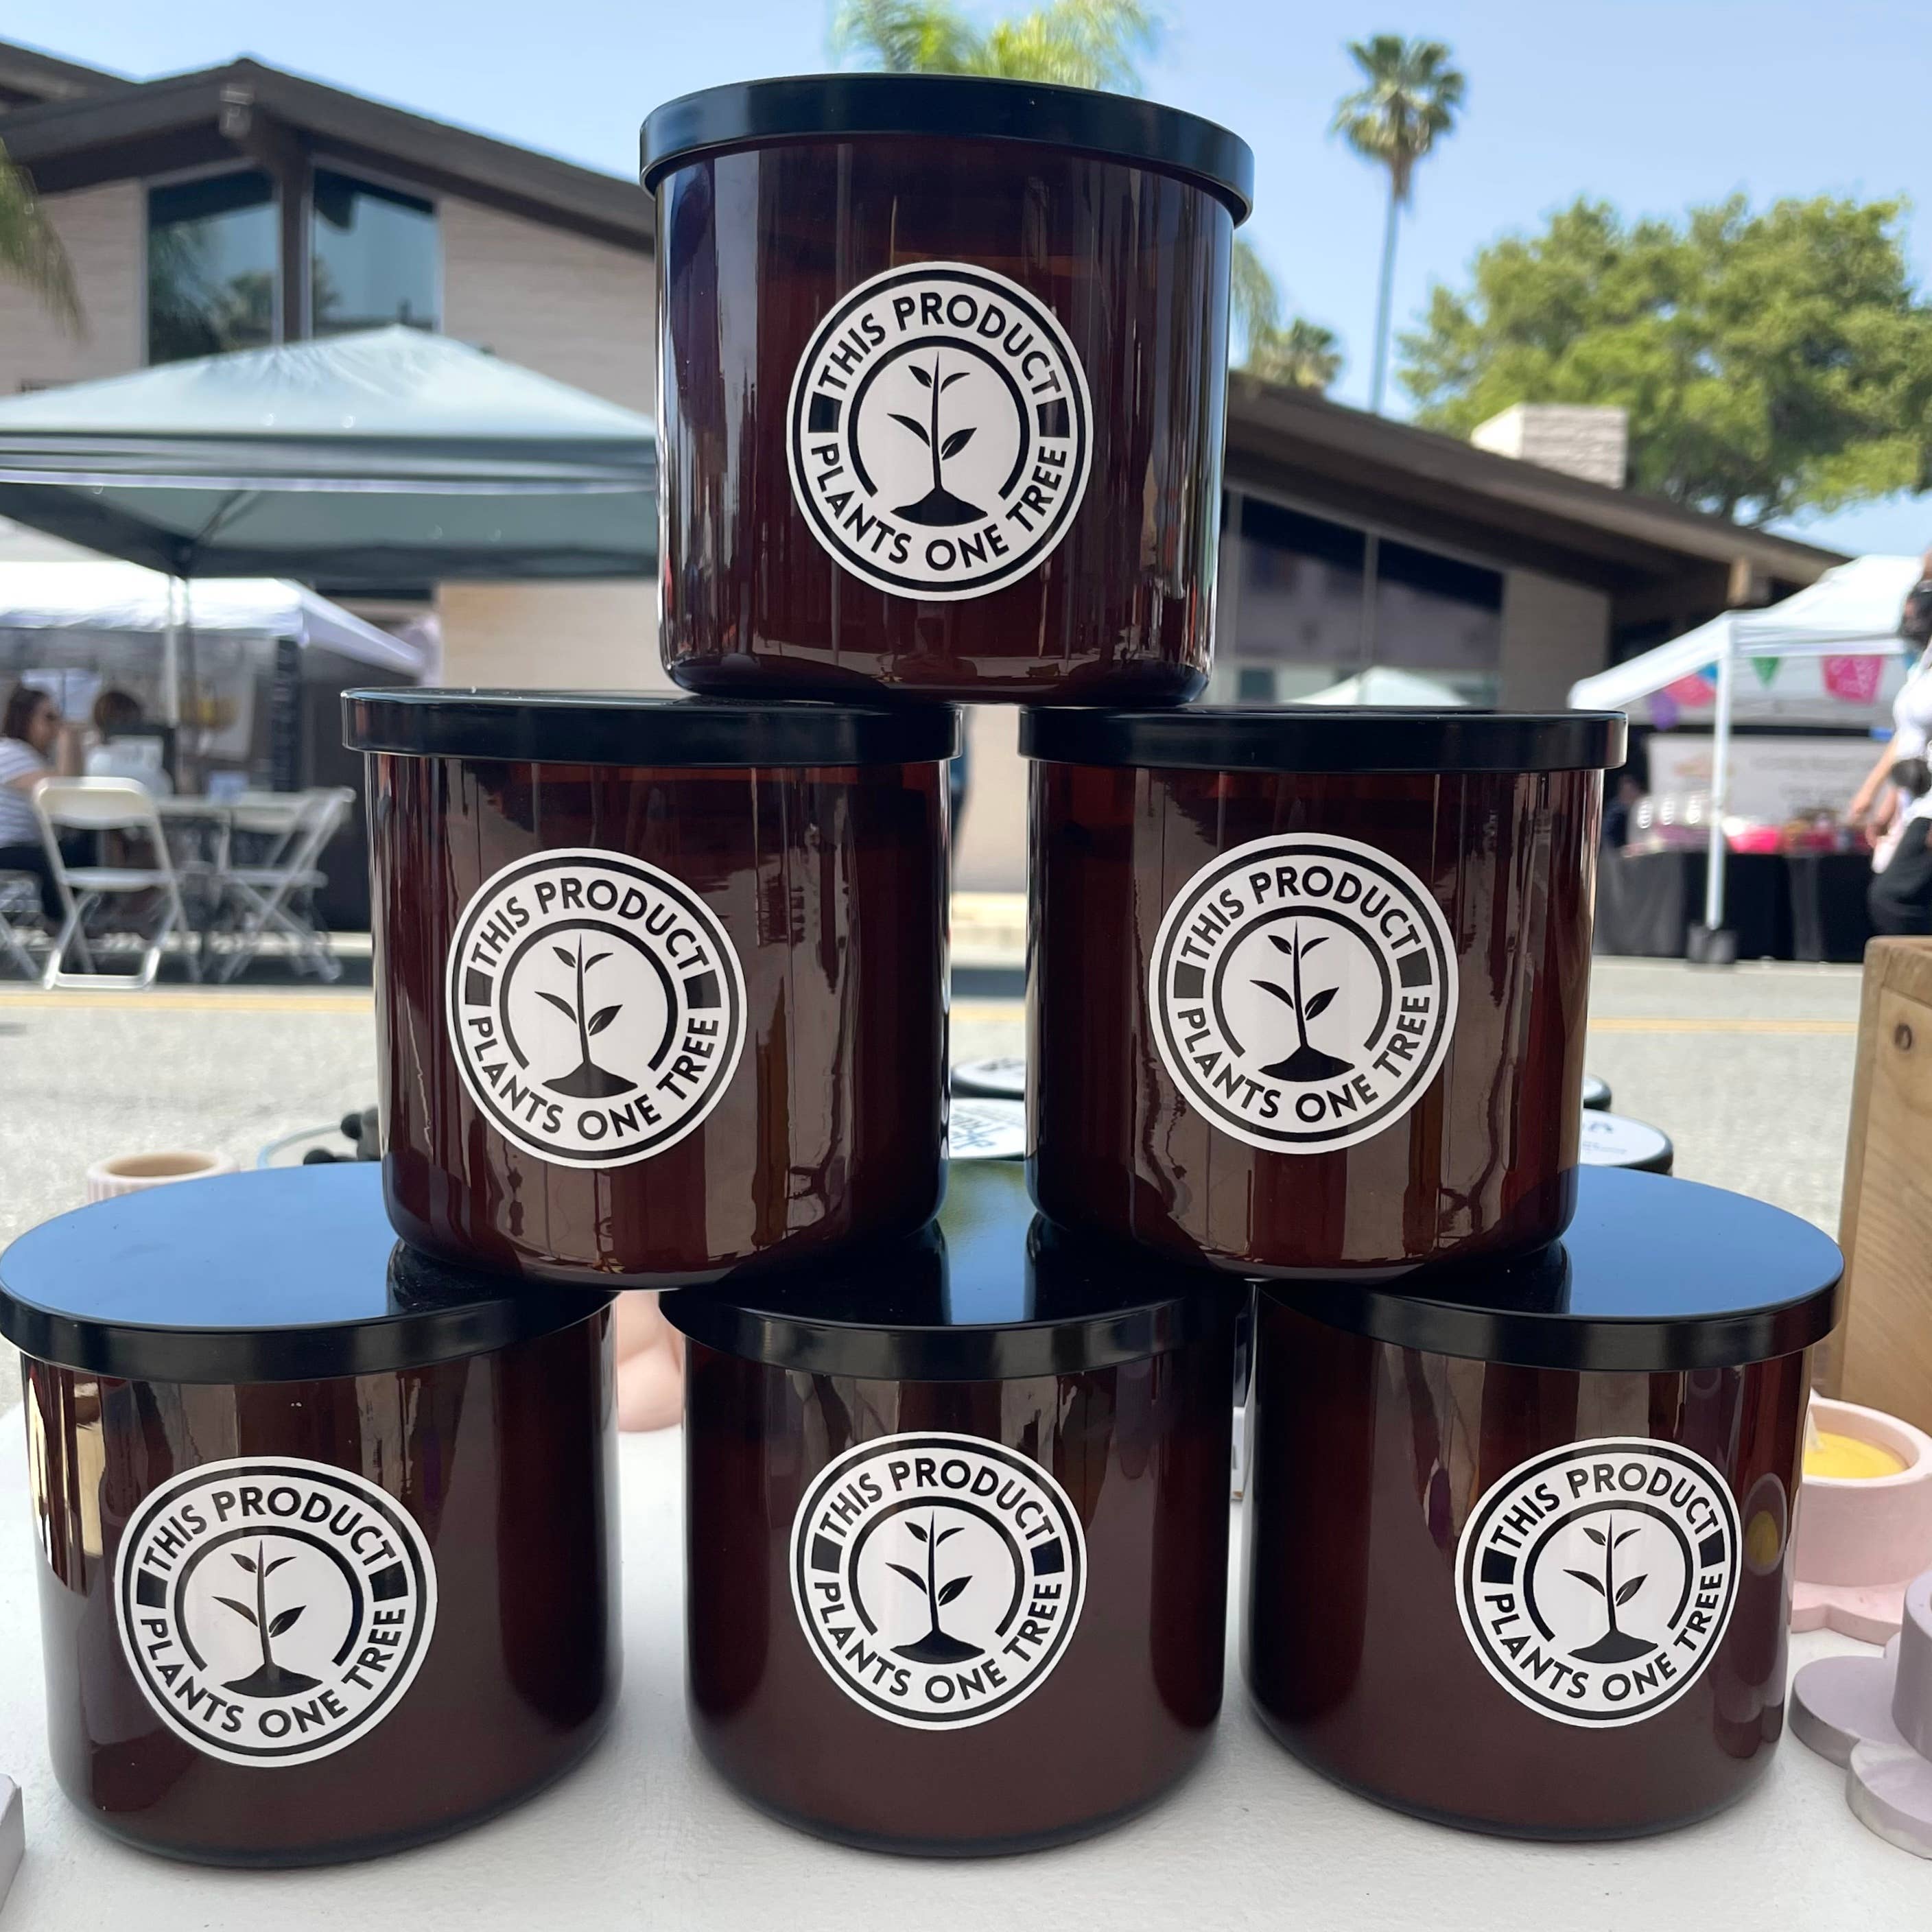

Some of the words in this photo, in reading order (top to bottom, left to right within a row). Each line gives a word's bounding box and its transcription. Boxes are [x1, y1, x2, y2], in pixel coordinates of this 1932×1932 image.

[817, 312, 886, 391] THIS
[893, 292, 1061, 395] PRODUCT
[811, 443, 912, 564] PLANTS
[925, 523, 1010, 571] ONE
[1005, 445, 1067, 532] TREE
[470, 896, 530, 967] THIS
[534, 877, 711, 970] PRODUCT
[1181, 888, 1245, 961] THIS
[1249, 865, 1422, 950] PRODUCT
[468, 1015, 564, 1134] PLANTS
[577, 1094, 663, 1141] ONE
[657, 1017, 719, 1100] TREE
[1177, 1007, 1282, 1118] PLANTS
[1295, 1074, 1378, 1123] ONE
[1372, 996, 1430, 1079] TREE
[143, 1504, 207, 1571] THIS
[211, 1486, 397, 1566] PRODUCT
[818, 1472, 883, 1538] THIS
[888, 1457, 1056, 1540] PRODUCT
[1489, 1483, 1561, 1548] THIS
[1566, 1462, 1718, 1535] PRODUCT
[140, 1618, 244, 1733] PLANTS
[258, 1689, 349, 1738] ONE
[341, 1608, 406, 1690] TREE
[814, 1581, 912, 1696] PLANTS
[925, 1658, 1008, 1704] ONE
[1002, 1583, 1062, 1662] TREE
[1484, 1592, 1589, 1699] PLANTS
[1602, 1651, 1677, 1701] ONE
[1673, 1572, 1723, 1651] TREE
